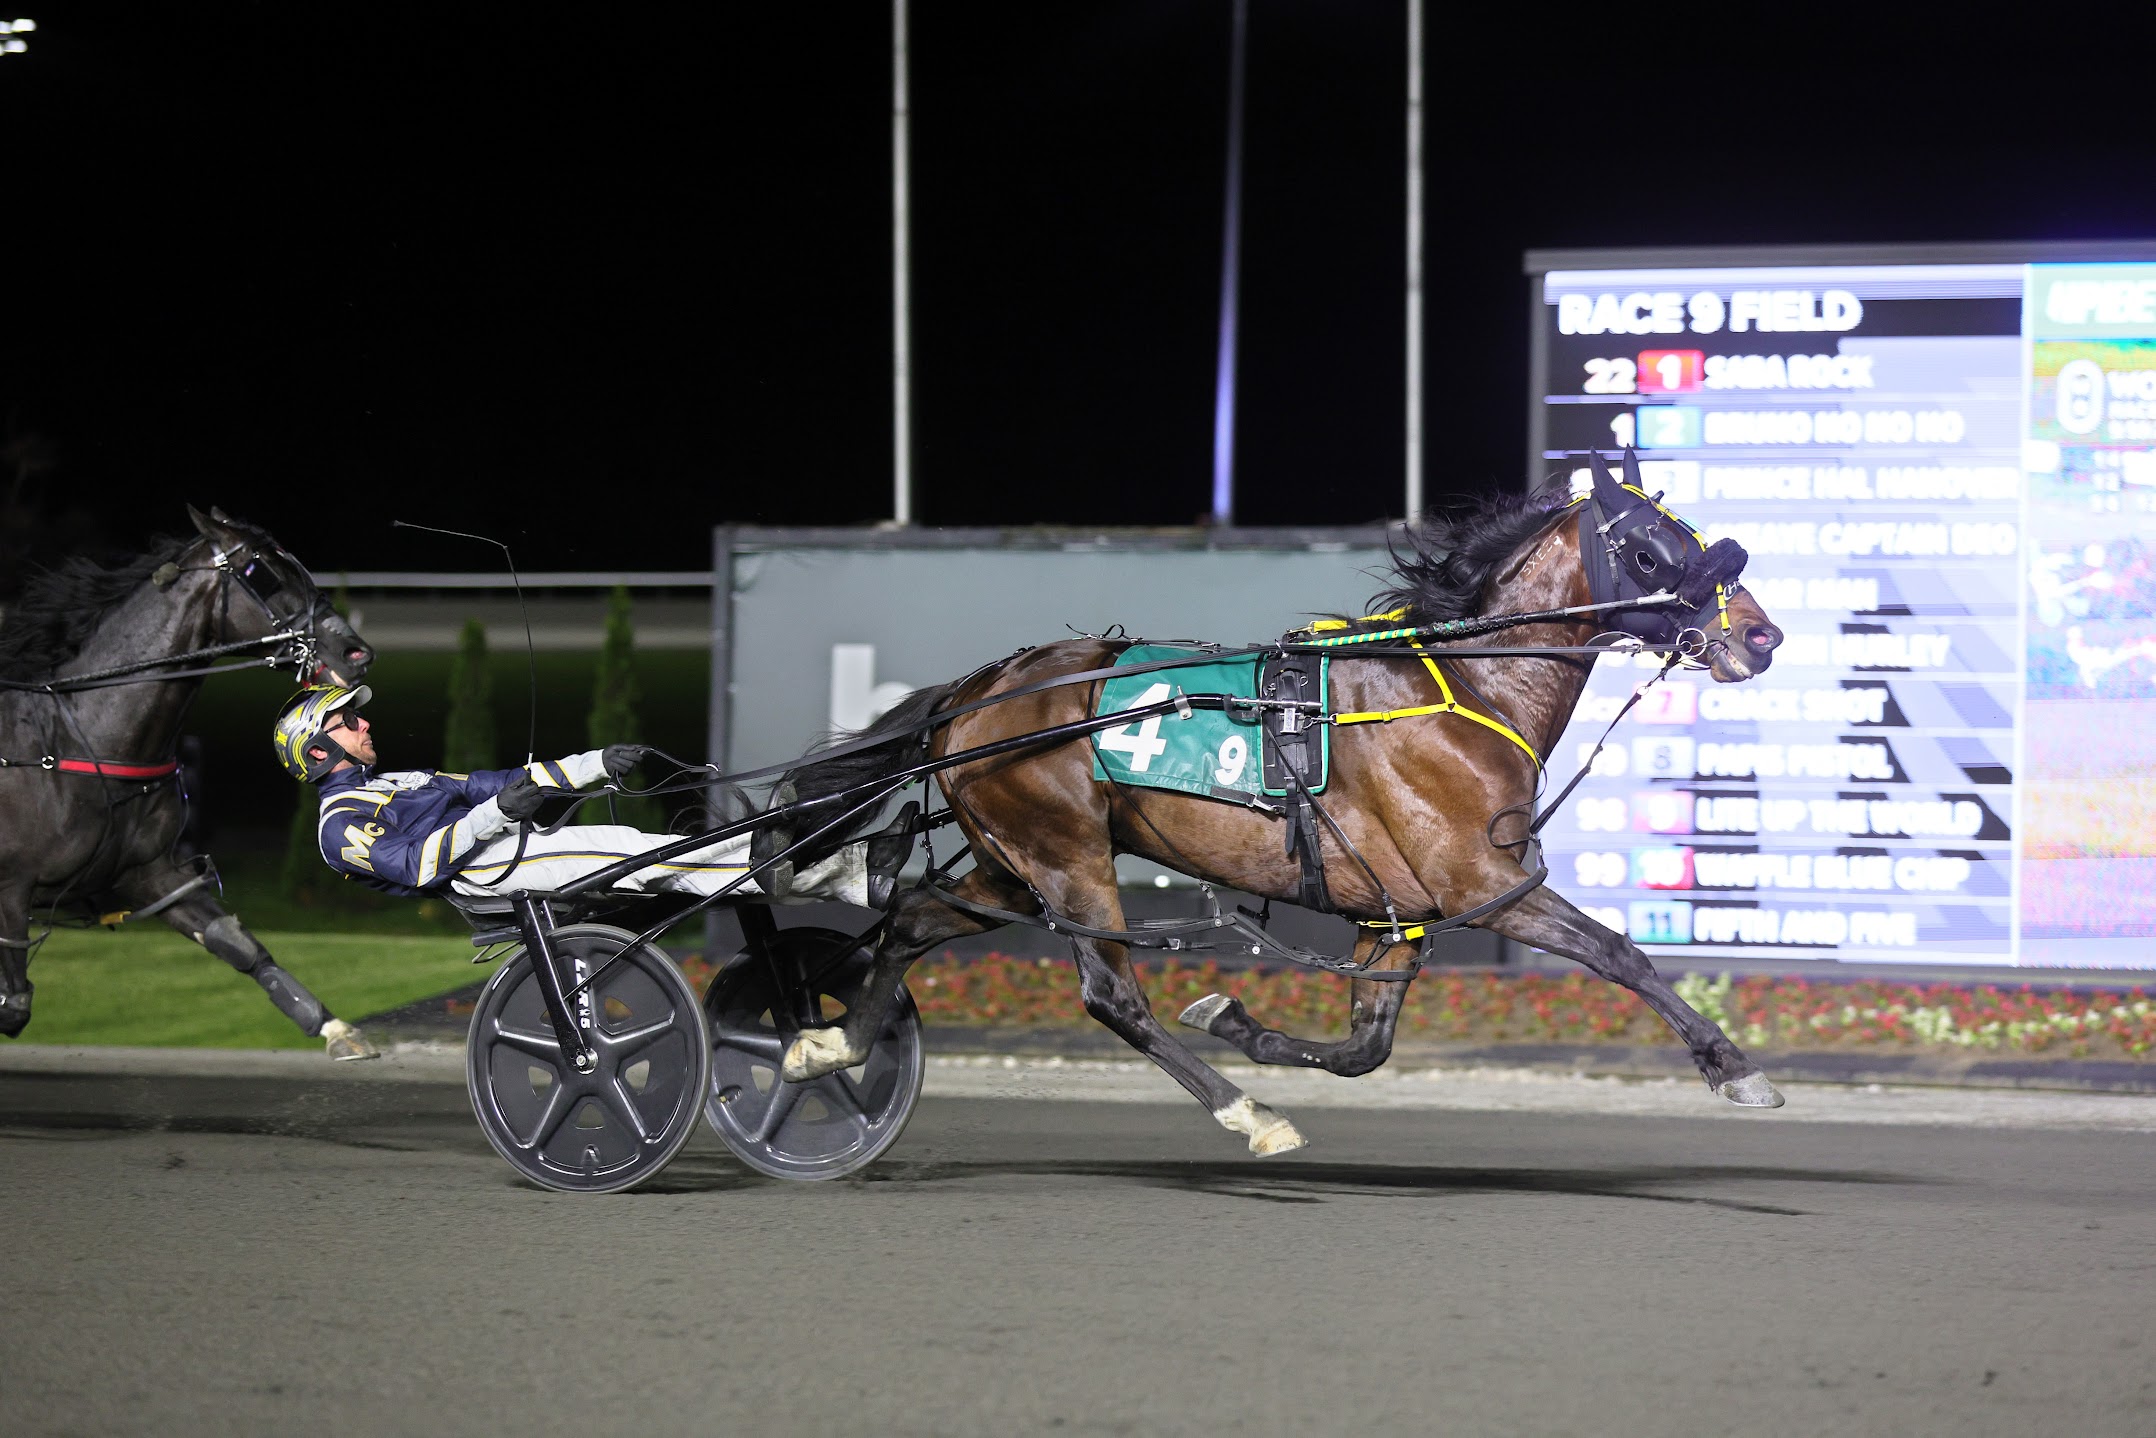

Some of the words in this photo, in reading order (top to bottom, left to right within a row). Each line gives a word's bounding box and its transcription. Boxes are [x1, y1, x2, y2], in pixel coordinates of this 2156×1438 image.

[1559, 293, 1682, 334] RACE
[1691, 292, 1722, 332] 9
[1731, 290, 1861, 332] FIELD
[1585, 360, 1635, 393] 22
[1656, 356, 1682, 389] 1
[1788, 355, 1873, 388] ROCK
[1610, 413, 1635, 447] 1
[1655, 410, 1684, 445] 2
[1820, 522, 1947, 555] CAPTAIN
[1656, 690, 1675, 716] 7
[1803, 688, 1885, 722] SHOT
[1099, 683, 1170, 771] 4
[1215, 735, 1247, 785] 9
[1653, 743, 1673, 771] 8
[1697, 798, 1758, 832] LITE
[1761, 799, 1806, 832] UP
[1809, 799, 1866, 833] THE
[1869, 800, 1982, 834] WORLD
[1814, 854, 1892, 889] BLUE
[1647, 911, 1672, 935] 11
[1694, 908, 1778, 942] FIFTH
[1781, 911, 1847, 943] AND
[1850, 912, 1916, 945] FIVE
